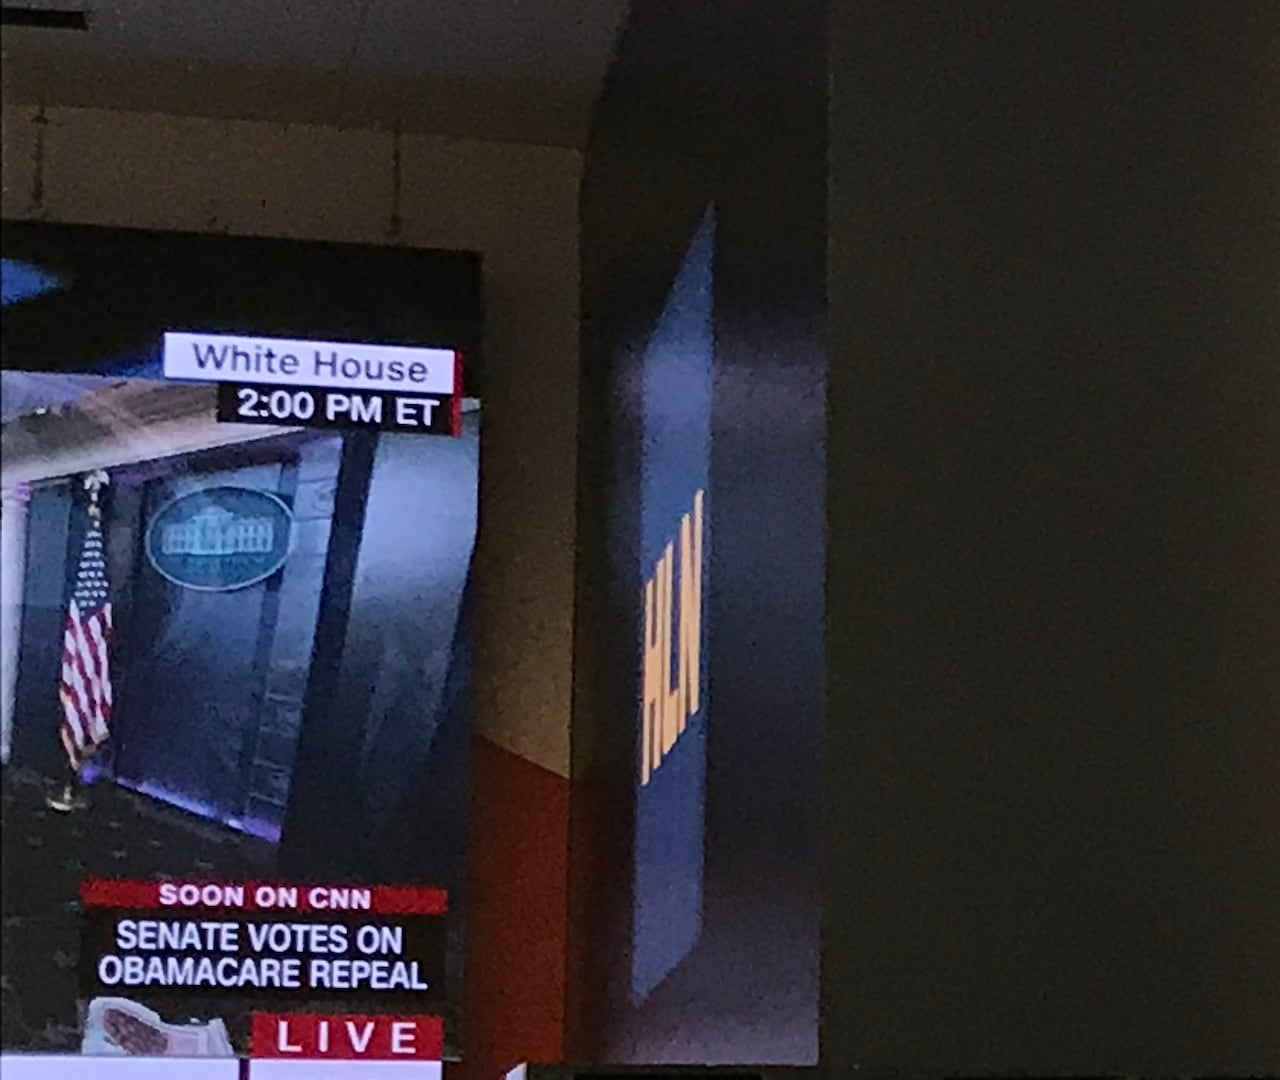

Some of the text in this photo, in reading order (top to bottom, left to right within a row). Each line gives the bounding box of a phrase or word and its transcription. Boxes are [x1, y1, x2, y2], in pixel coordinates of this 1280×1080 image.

[192, 342, 428, 383] White House
[237, 388, 440, 426] 2:00 PM ET
[641, 489, 704, 785] HLN
[159, 883, 371, 910] SOON ON CNN
[116, 919, 403, 954] SENATE VOTES ON
[98, 955, 428, 990] OBAMACARE REPEAL
[277, 1021, 417, 1054] LIVE
